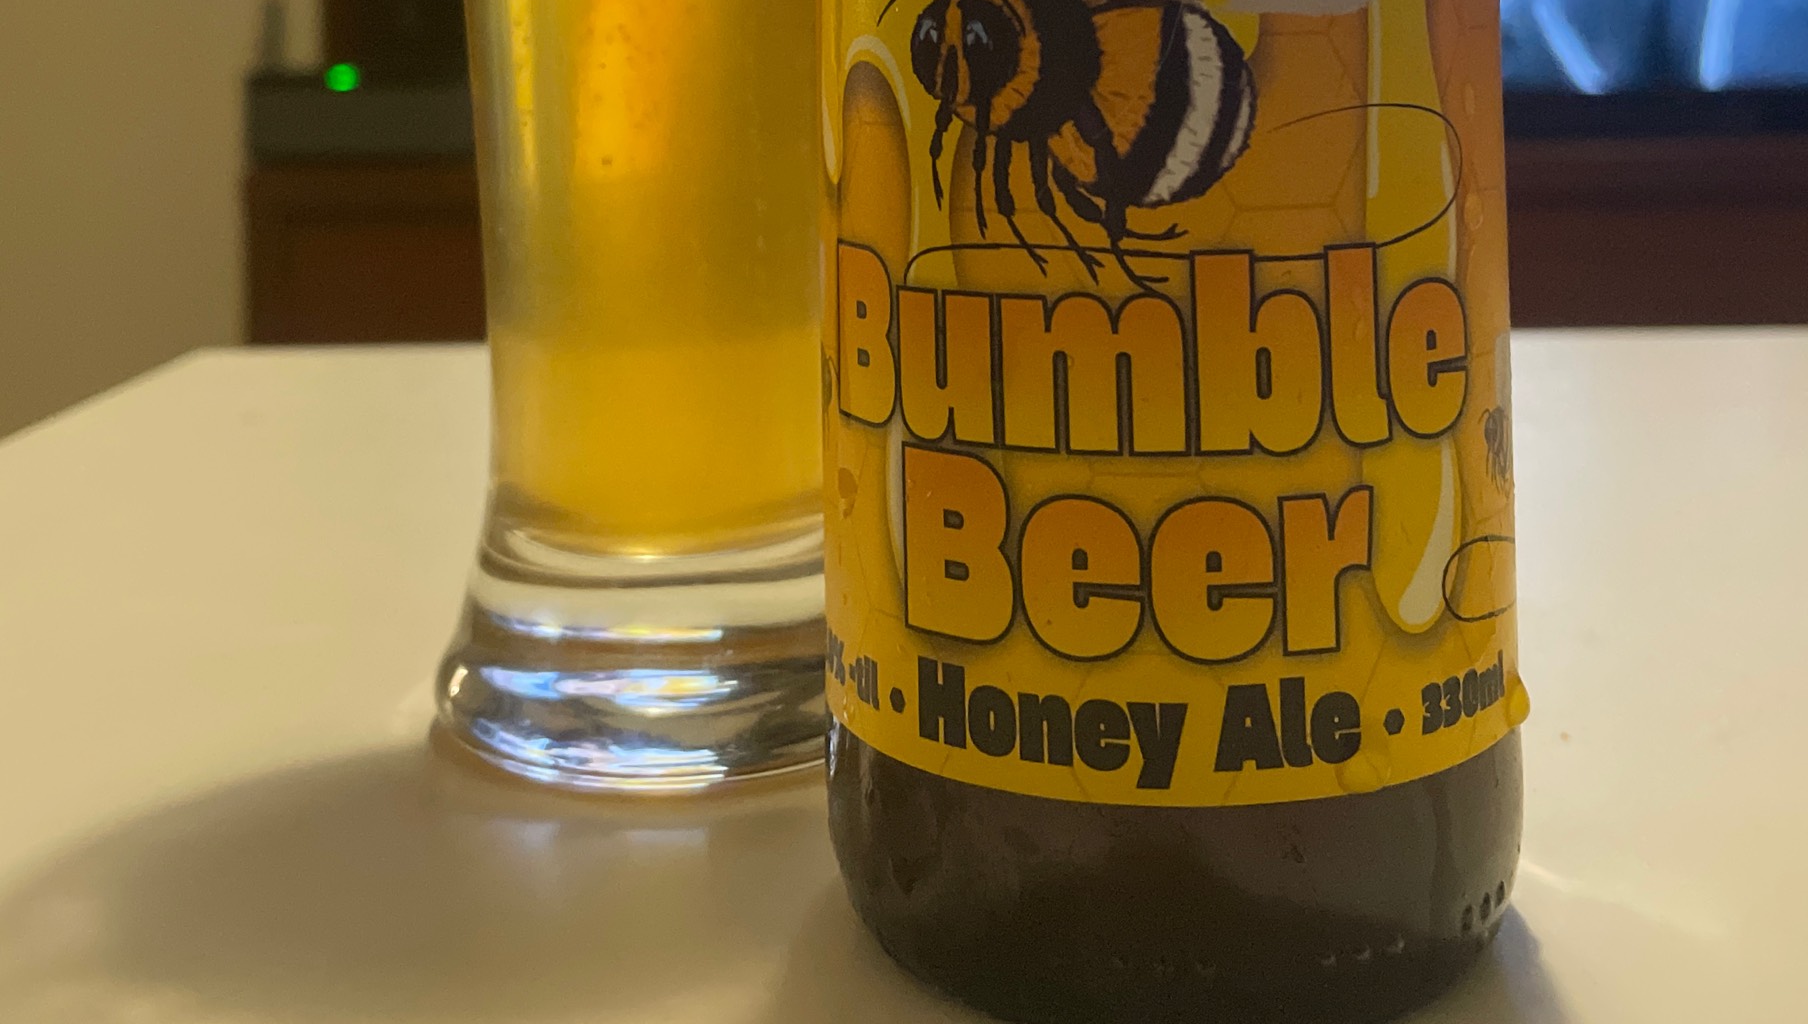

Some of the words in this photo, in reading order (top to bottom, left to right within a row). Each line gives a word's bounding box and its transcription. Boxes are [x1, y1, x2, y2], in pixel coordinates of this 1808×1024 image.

[837, 240, 1469, 457] Bumble
[901, 439, 1375, 663] Beer
[917, 654, 1188, 789] Honey
[1213, 676, 1362, 773] Ale
[1421, 649, 1505, 736] 330ml
